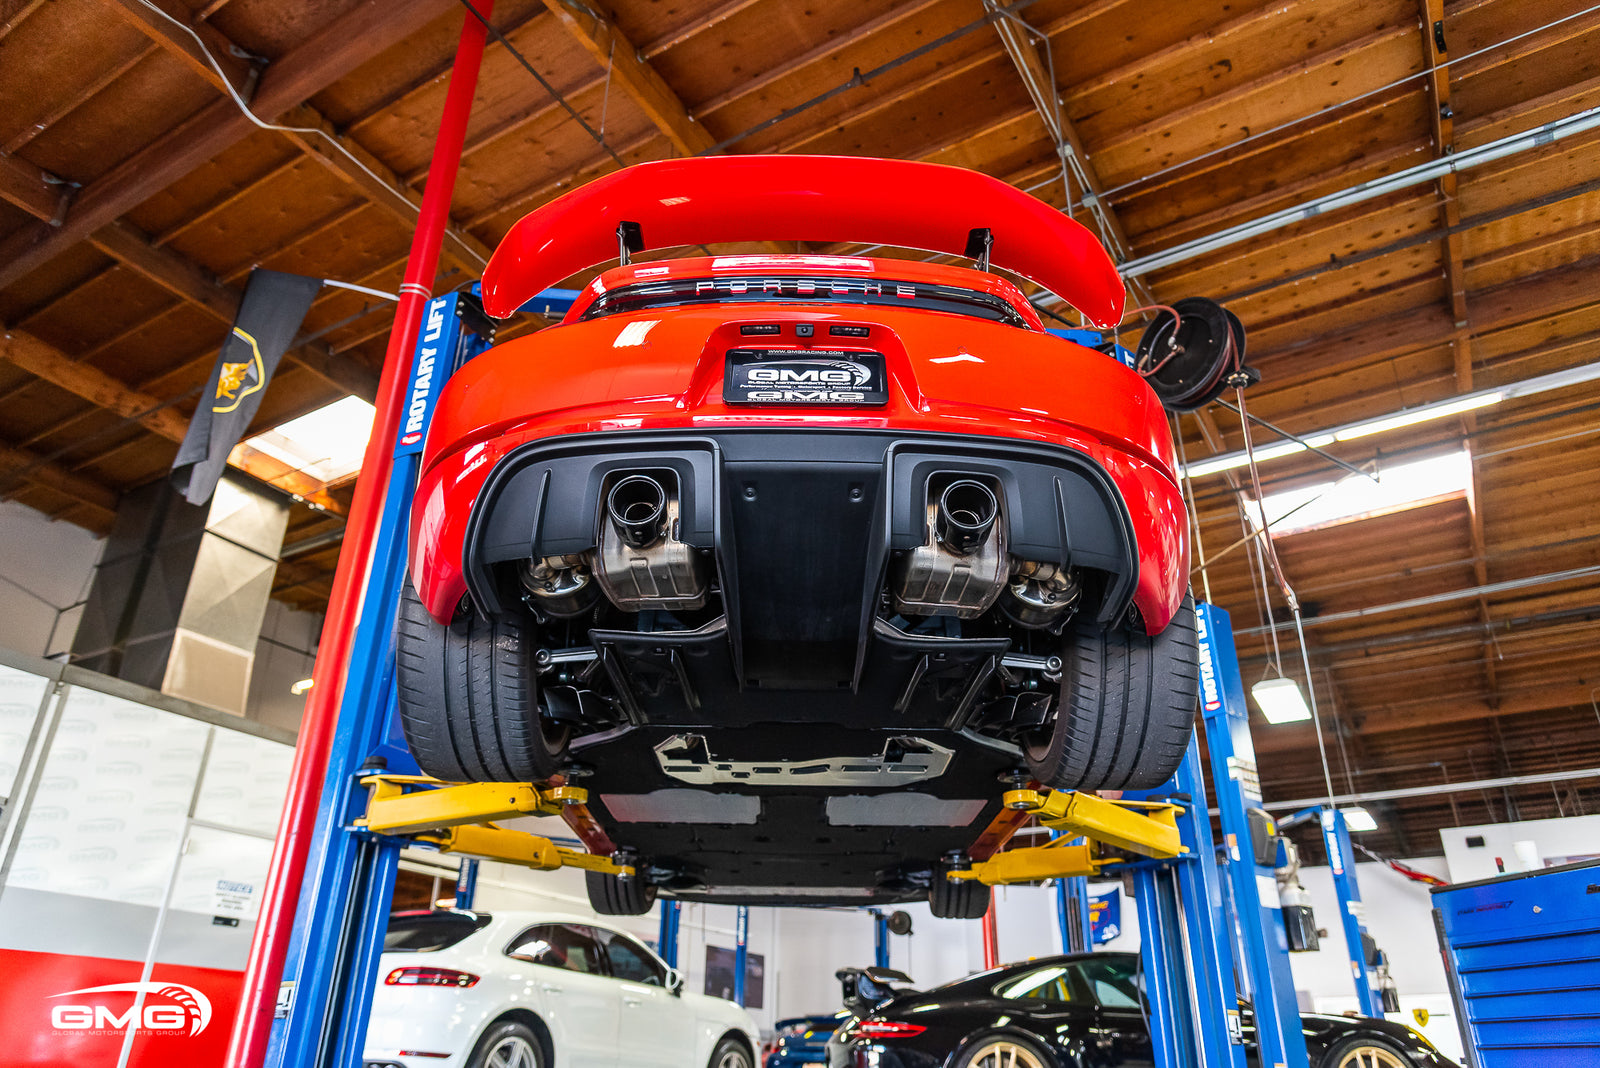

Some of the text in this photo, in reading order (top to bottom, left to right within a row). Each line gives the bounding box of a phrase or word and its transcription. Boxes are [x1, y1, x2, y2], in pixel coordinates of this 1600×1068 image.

[696, 280, 916, 299] PORSCHE
[405, 300, 447, 433] ROTARY LIFT
[748, 369, 851, 382] GMG
[747, 391, 865, 400] GMG
[52, 1005, 185, 1029] GMG
